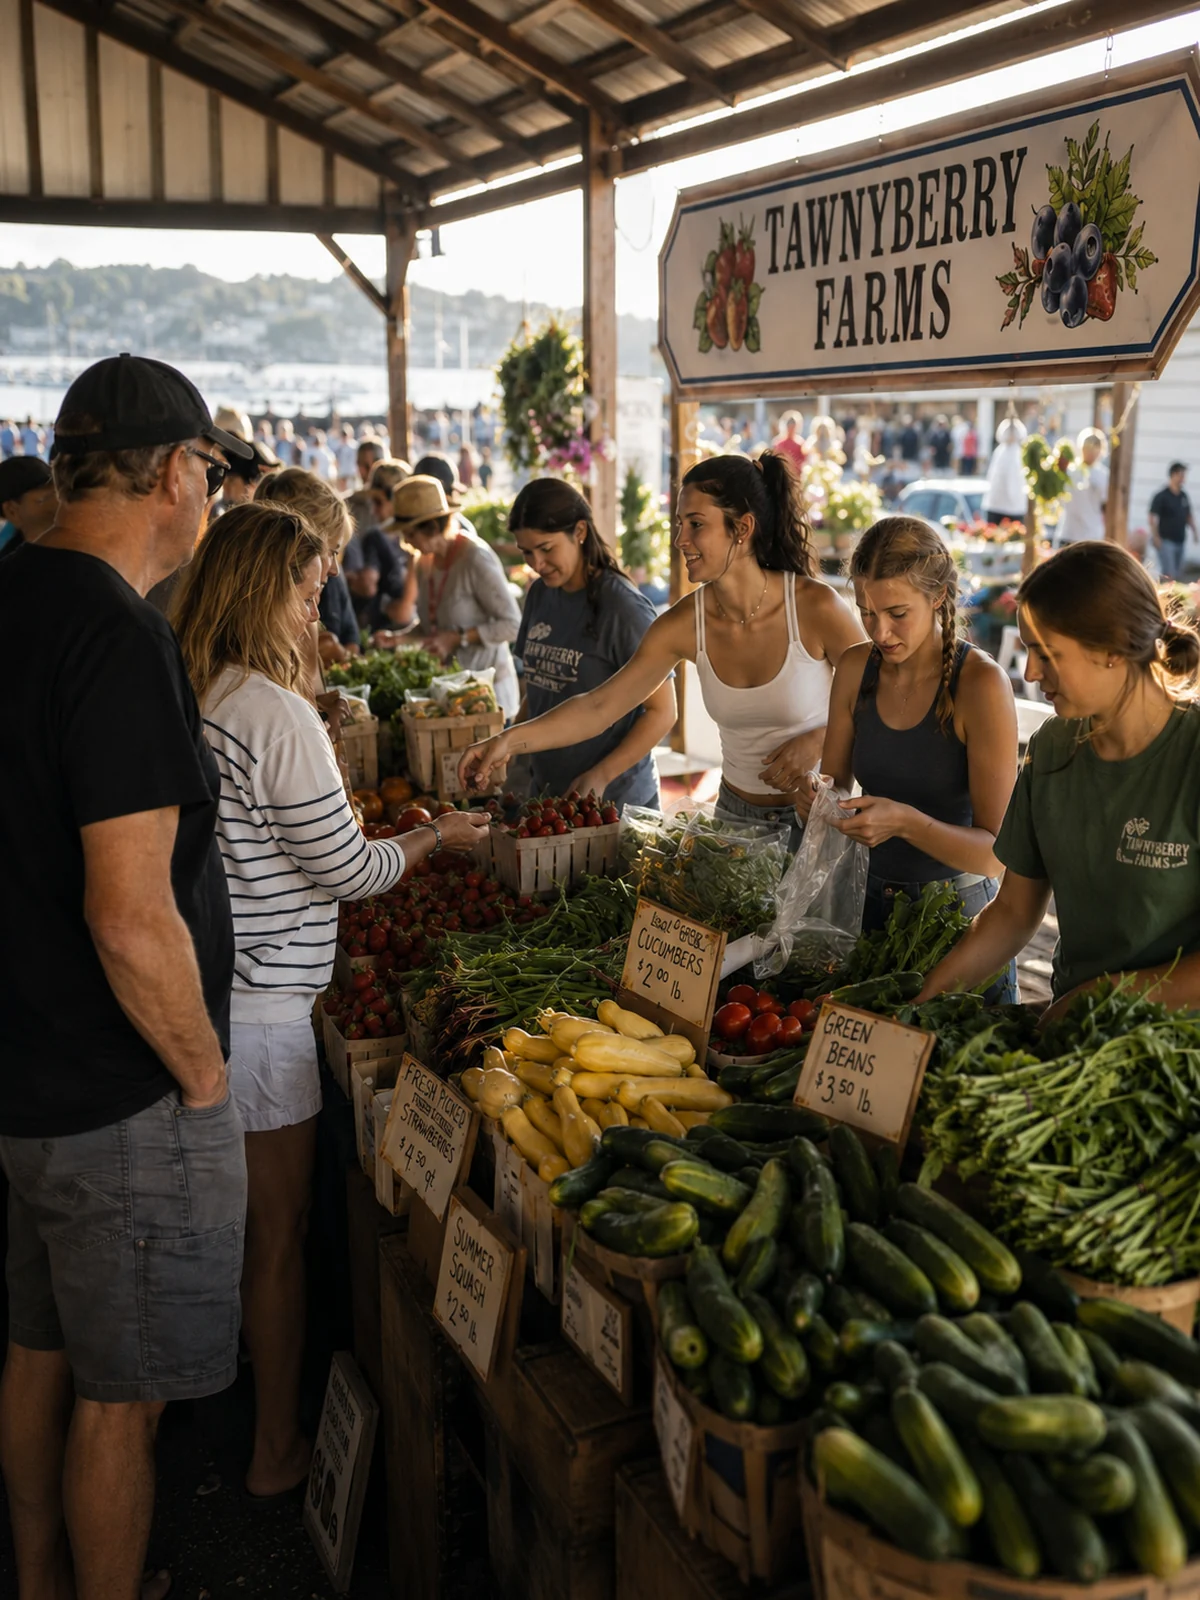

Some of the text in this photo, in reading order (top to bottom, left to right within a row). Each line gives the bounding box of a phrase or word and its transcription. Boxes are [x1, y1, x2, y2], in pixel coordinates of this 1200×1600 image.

[765, 146, 1028, 275] TAWNYBERRY
[814, 259, 952, 350] FARMS
[1134, 853, 1171, 869] FARMS
[637, 927, 704, 976] CUCUMBERS
[823, 1011, 874, 1044] GREEN
[825, 1040, 876, 1076] BEANS
[403, 1062, 438, 1102] FRESH
[856, 1088, 873, 1116] lb.
[453, 1216, 495, 1281] SUMMER
[449, 1252, 487, 1309] SQUASH
